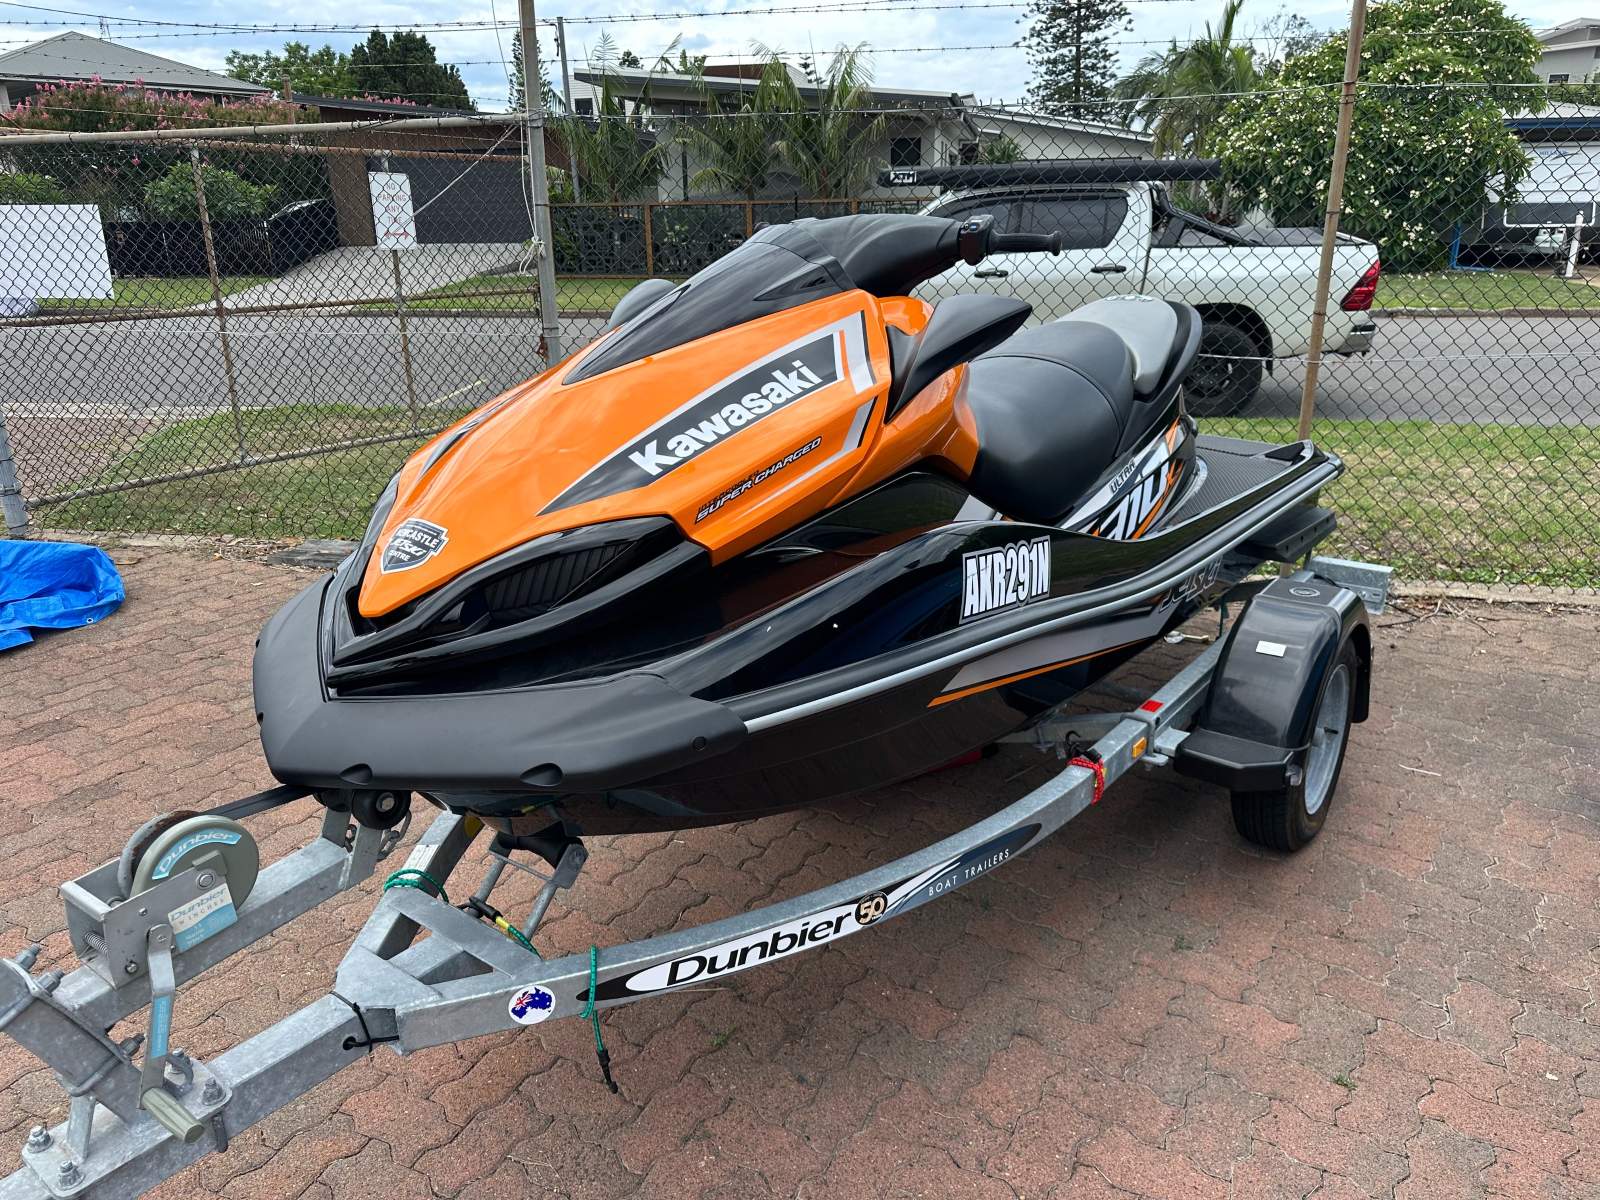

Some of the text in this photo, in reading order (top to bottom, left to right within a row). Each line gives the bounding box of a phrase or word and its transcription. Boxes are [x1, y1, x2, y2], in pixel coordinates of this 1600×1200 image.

[386, 182, 396, 191] NO
[387, 216, 403, 224] TIE
[628, 360, 823, 476] Kawasaki
[696, 437, 822, 522] SUPER CHARGED
[1109, 459, 1136, 494] ULTRA
[962, 538, 1050, 618] AKR291N
[159, 830, 233, 873] Dunbier
[928, 848, 1010, 897] BOAT TRAILERS
[171, 887, 228, 922] Dunbier
[666, 896, 885, 986] Dunbier 50
